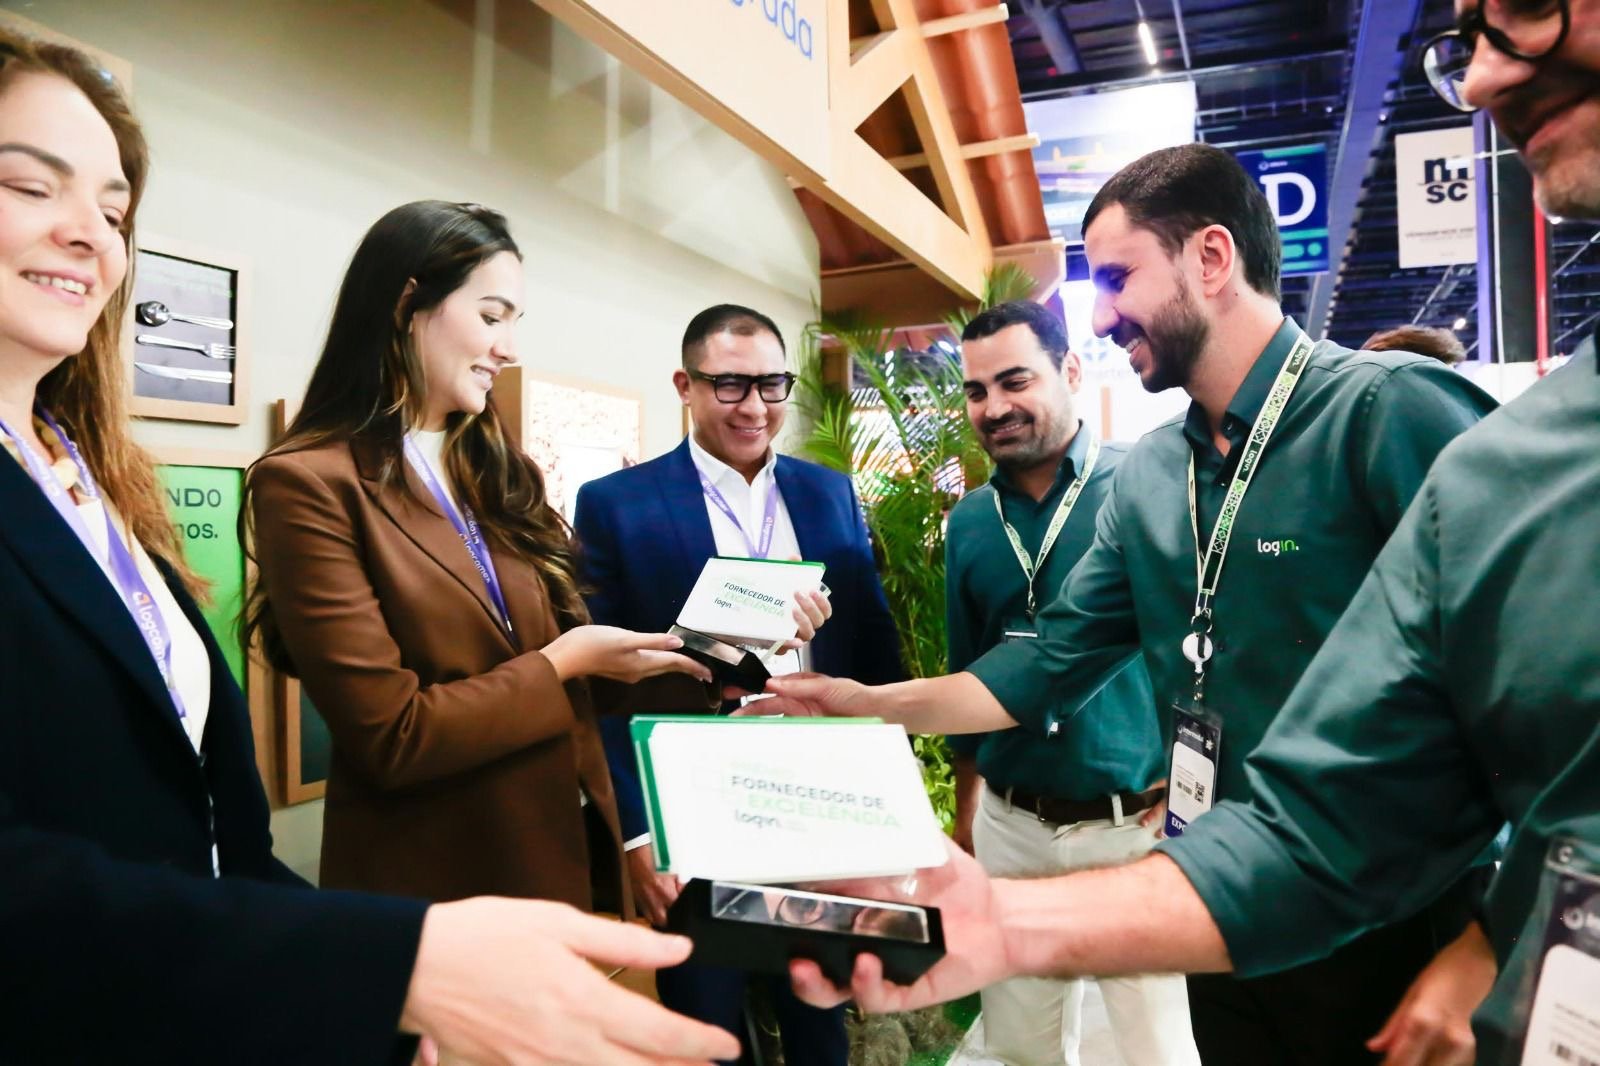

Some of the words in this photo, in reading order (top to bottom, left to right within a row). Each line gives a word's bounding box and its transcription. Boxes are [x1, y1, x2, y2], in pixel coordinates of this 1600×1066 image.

[1259, 172, 1317, 227] D
[1426, 182, 1468, 204] sc
[724, 582, 774, 603] FORNECEDOR
[774, 599, 786, 608] DE
[731, 775, 857, 805] FORNECEDOR
[863, 795, 885, 810] DE
